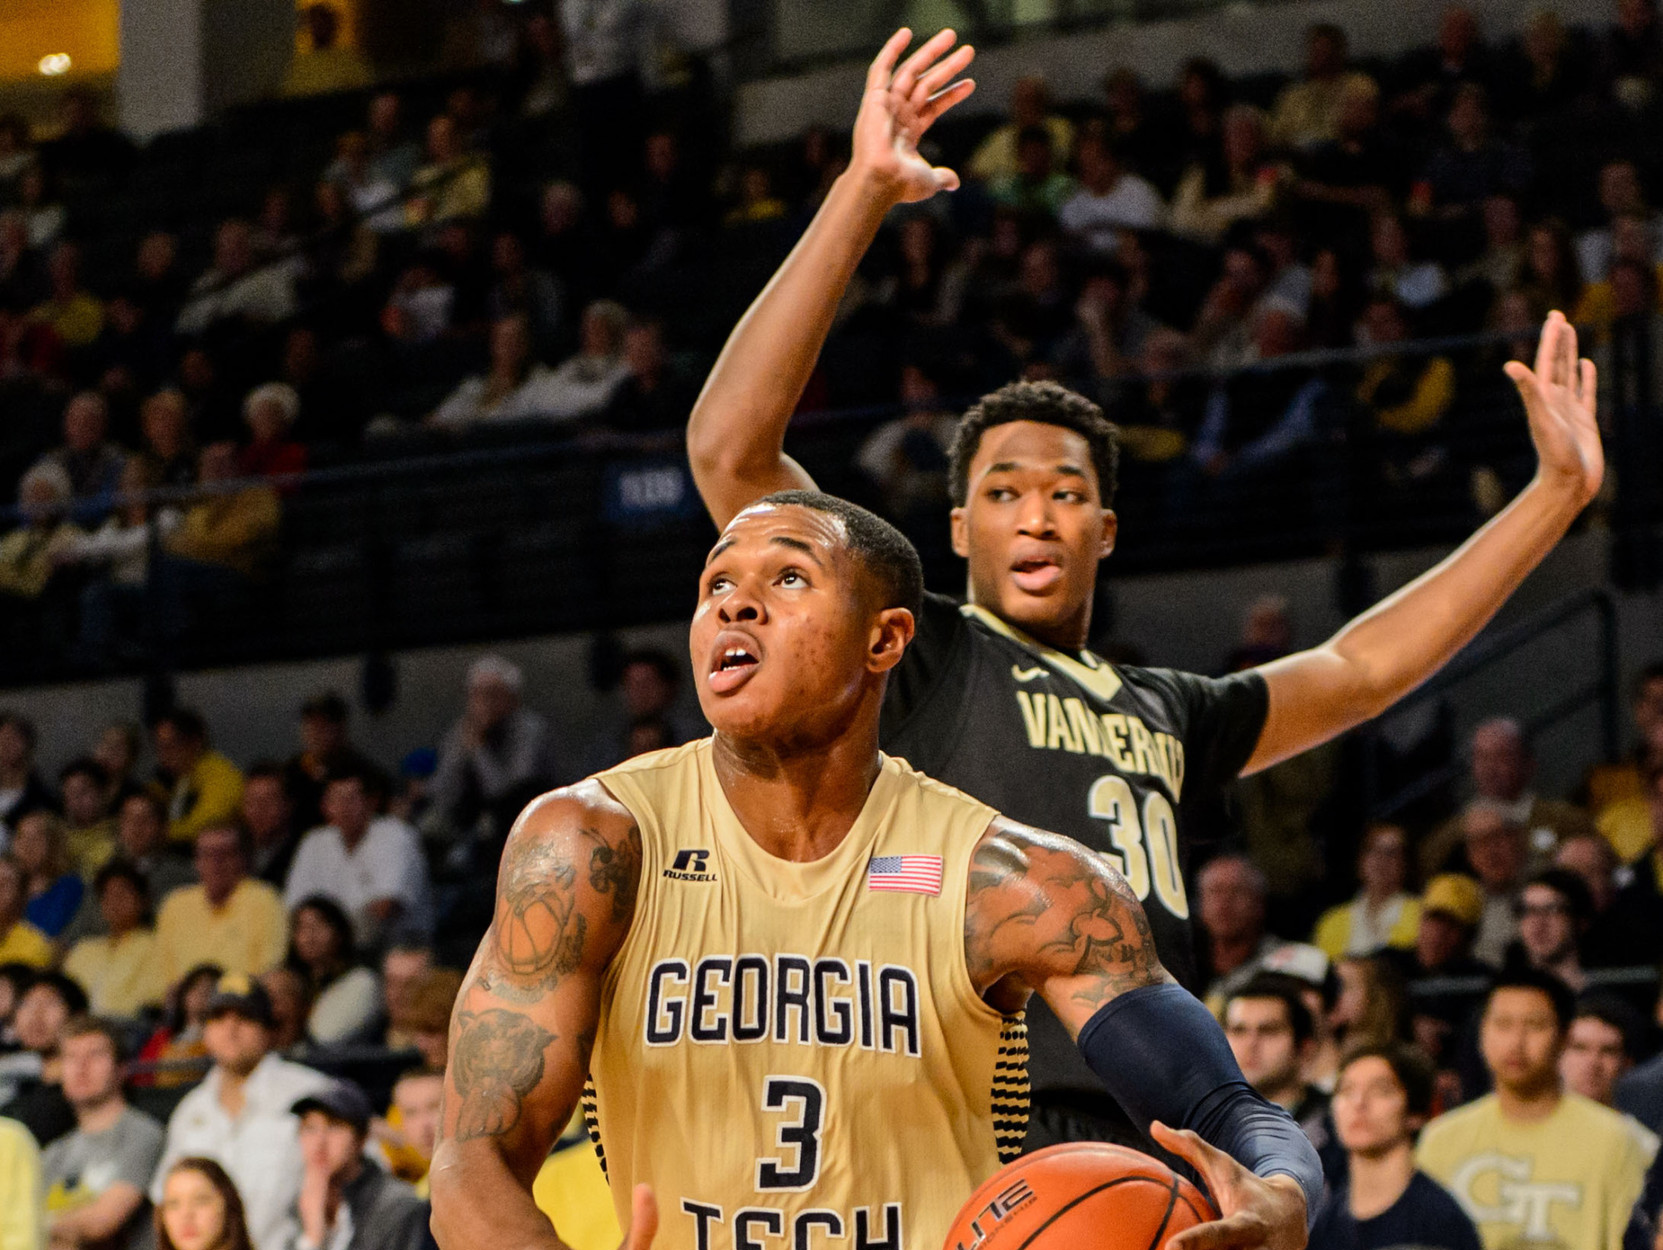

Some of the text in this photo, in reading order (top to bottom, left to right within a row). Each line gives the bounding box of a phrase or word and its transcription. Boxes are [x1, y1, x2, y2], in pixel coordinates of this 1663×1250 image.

[662, 869, 718, 882] RUSSELL
[1088, 775, 1189, 919] 30
[645, 952, 922, 1058] GEORGIA
[754, 1074, 827, 1194] 3
[1452, 1155, 1580, 1240] GT
